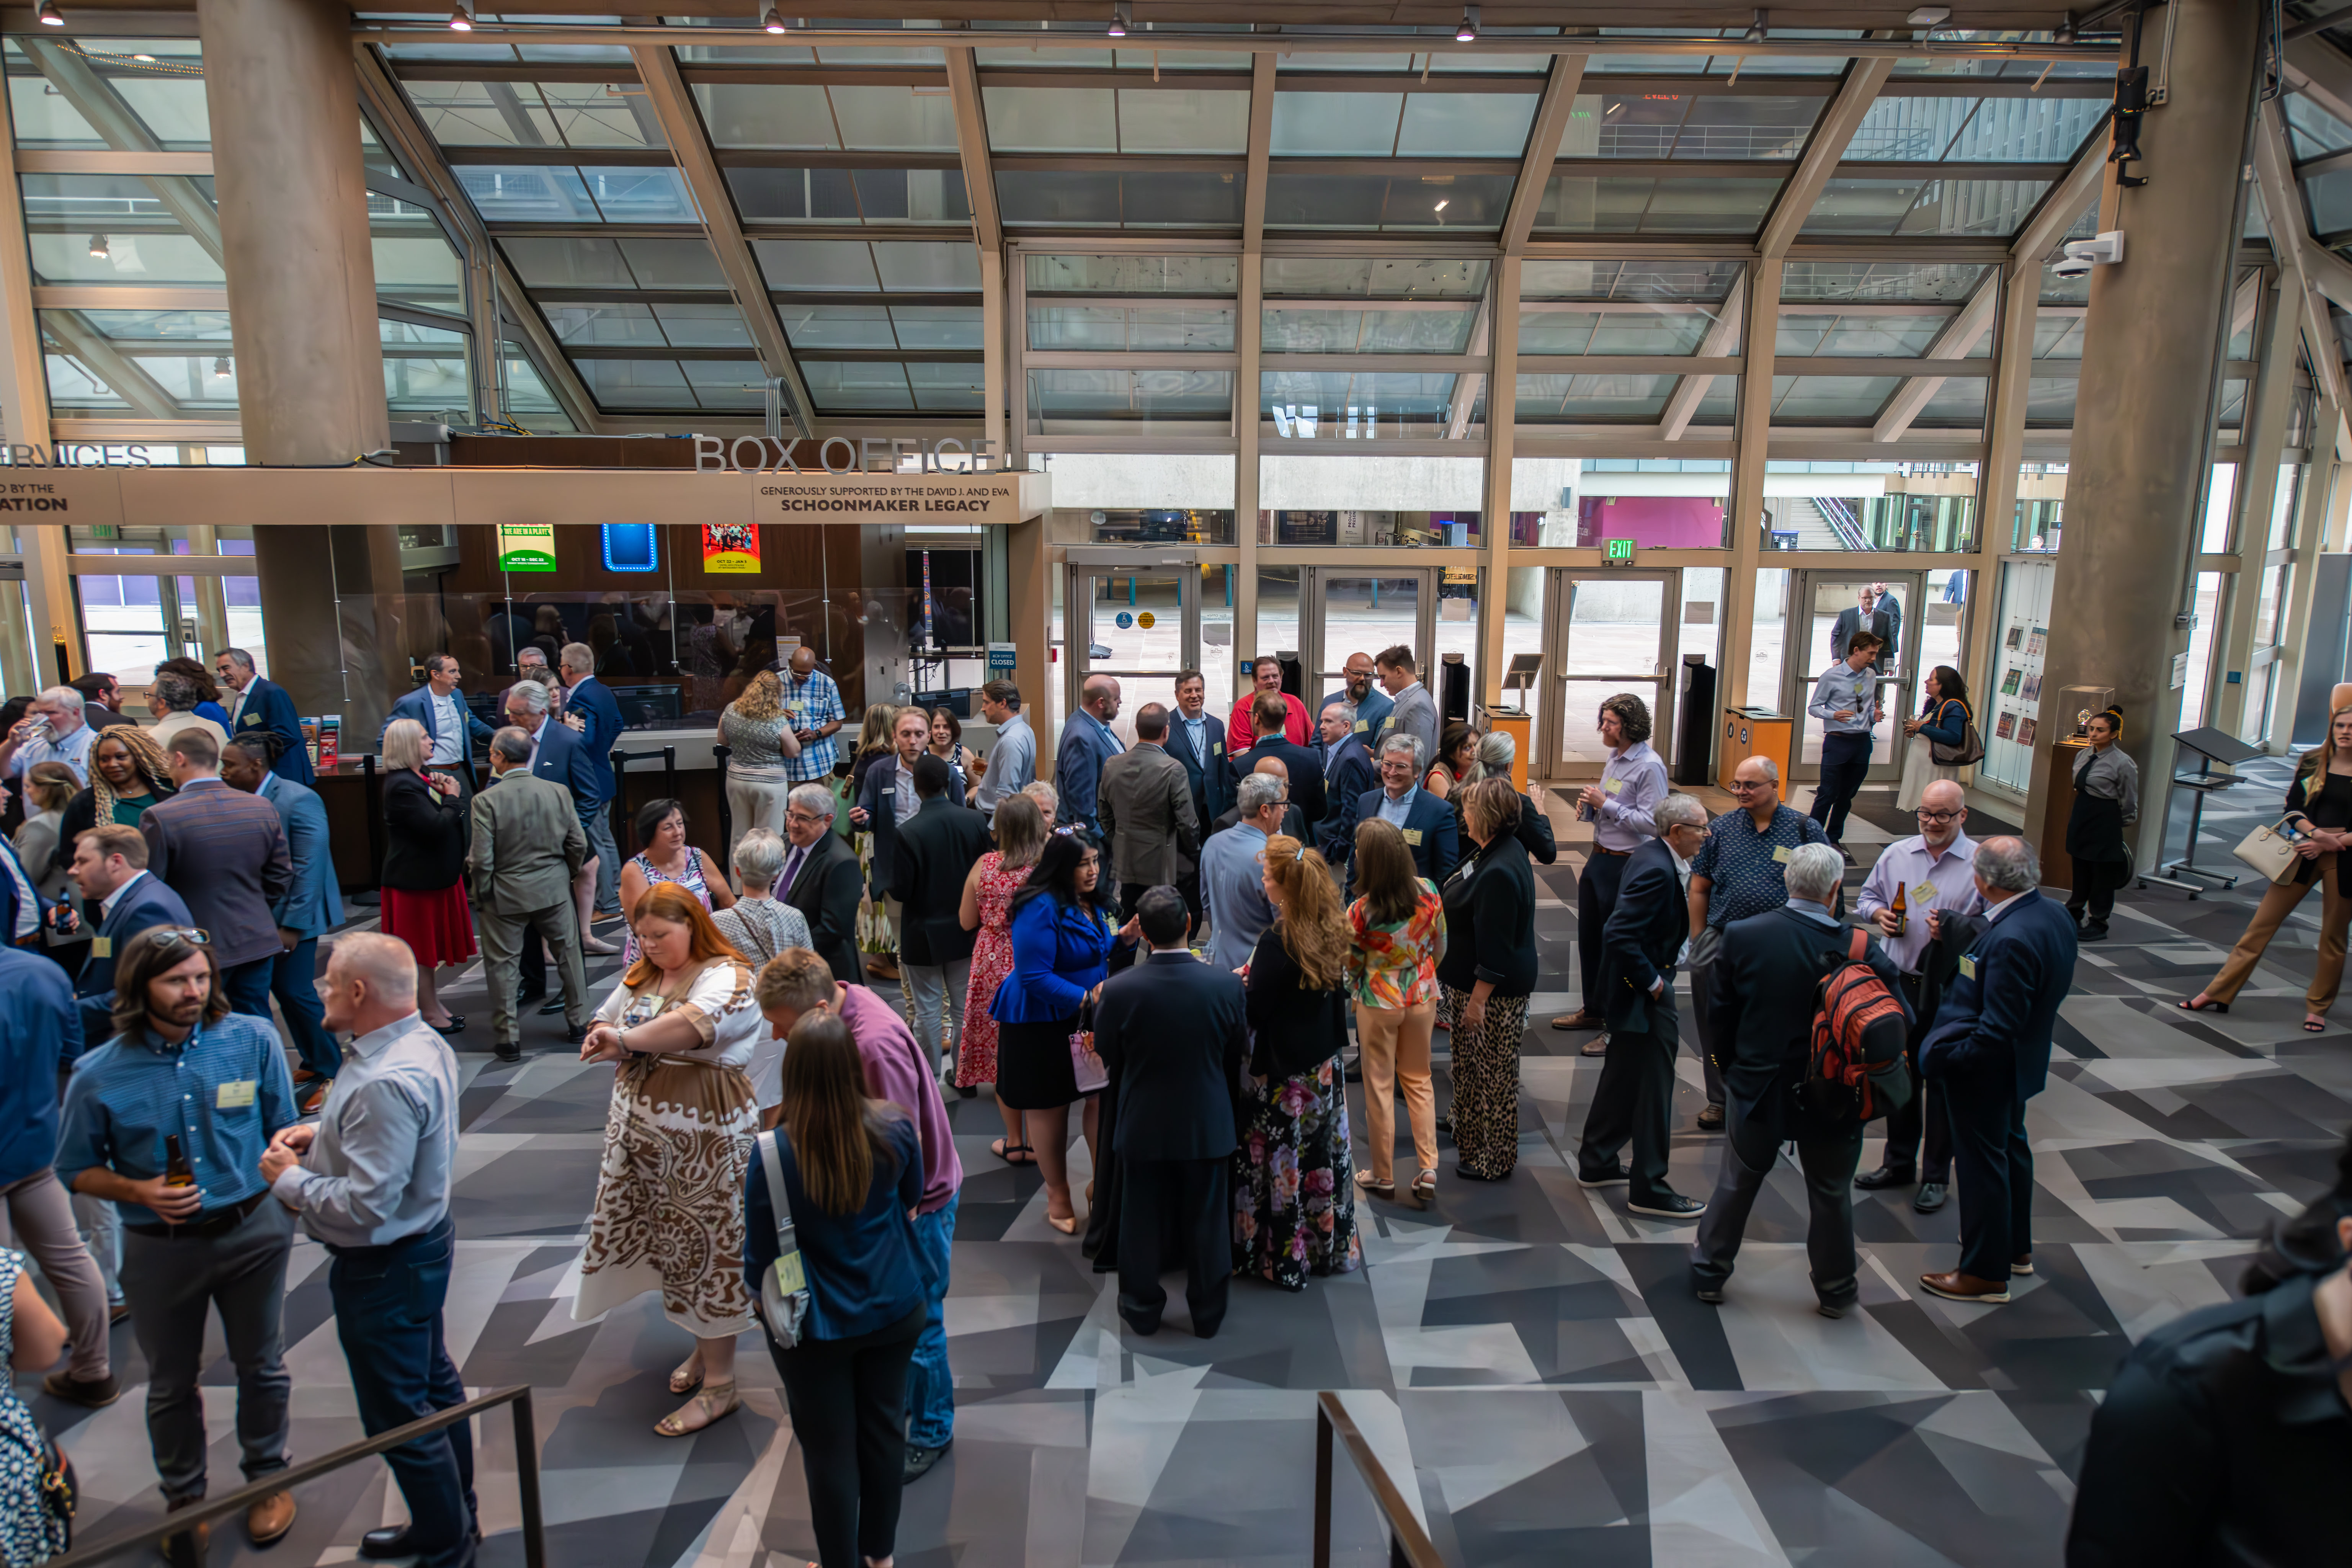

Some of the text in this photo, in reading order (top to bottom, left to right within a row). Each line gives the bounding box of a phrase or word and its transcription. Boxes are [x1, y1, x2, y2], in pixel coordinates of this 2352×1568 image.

[694, 436, 996, 476] BOX OFFICE
[10, 484, 26, 493] BY
[28, 484, 55, 493] THE
[761, 487, 827, 495] GENEROUSLY
[830, 487, 887, 496] SUPPORTED
[906, 488, 924, 496] THE
[927, 488, 956, 496] DAVID
[966, 488, 989, 496] AND
[992, 488, 1009, 496] EVA
[781, 500, 990, 511] SCHOONMAKER LEGACY
[1609, 540, 1633, 558] EXIT
